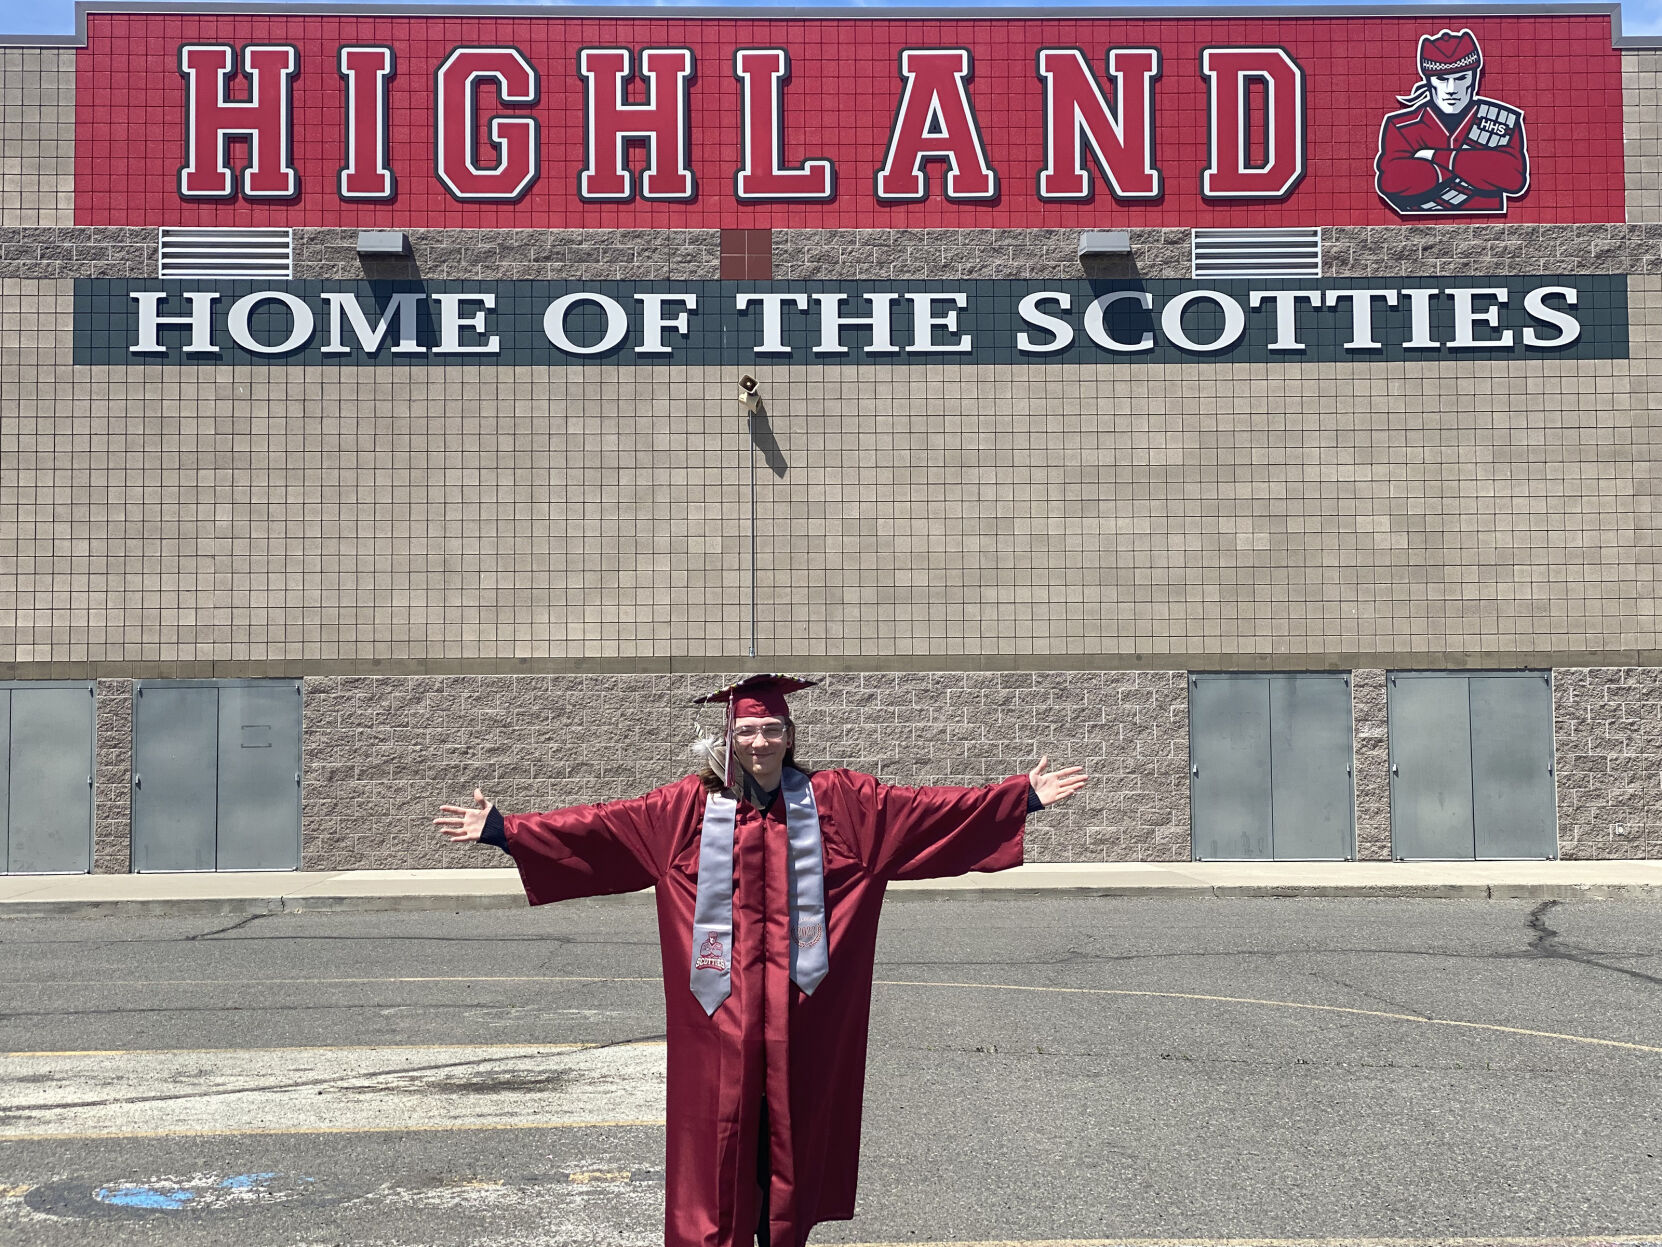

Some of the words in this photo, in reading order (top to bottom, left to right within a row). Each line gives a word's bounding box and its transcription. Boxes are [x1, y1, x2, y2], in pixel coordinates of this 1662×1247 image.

[177, 43, 1306, 203] HIGHLAND
[1480, 119, 1506, 135] HHS
[129, 291, 501, 354] HOME
[543, 292, 698, 354] OF
[735, 293, 973, 354] THE
[1016, 286, 1582, 353] SCOTTIES
[695, 957, 725, 970] SCOTTIES
